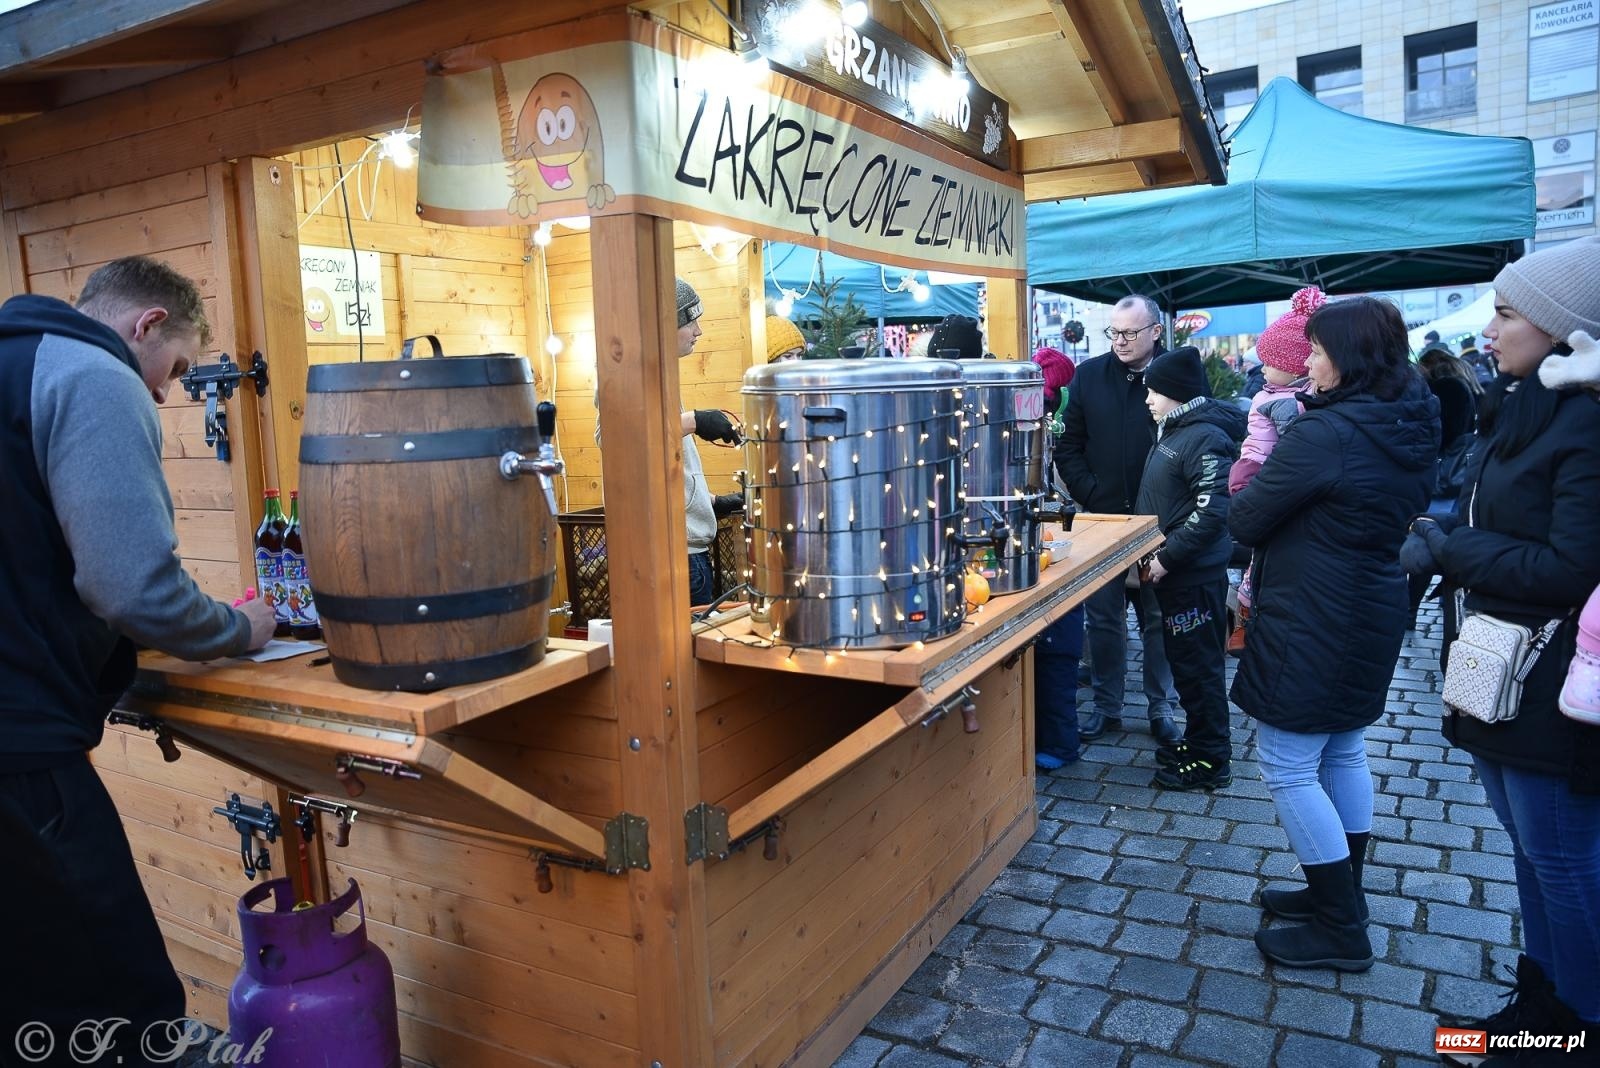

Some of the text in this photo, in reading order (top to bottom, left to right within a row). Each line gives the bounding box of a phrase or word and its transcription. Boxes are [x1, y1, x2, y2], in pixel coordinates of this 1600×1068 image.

[1534, 11, 1594, 31] ADWOKACKA
[1536, 1, 1593, 20] KANCELARIA
[915, 174, 1014, 258] ZIEMNIAKI
[1172, 610, 1213, 636] PEAK
